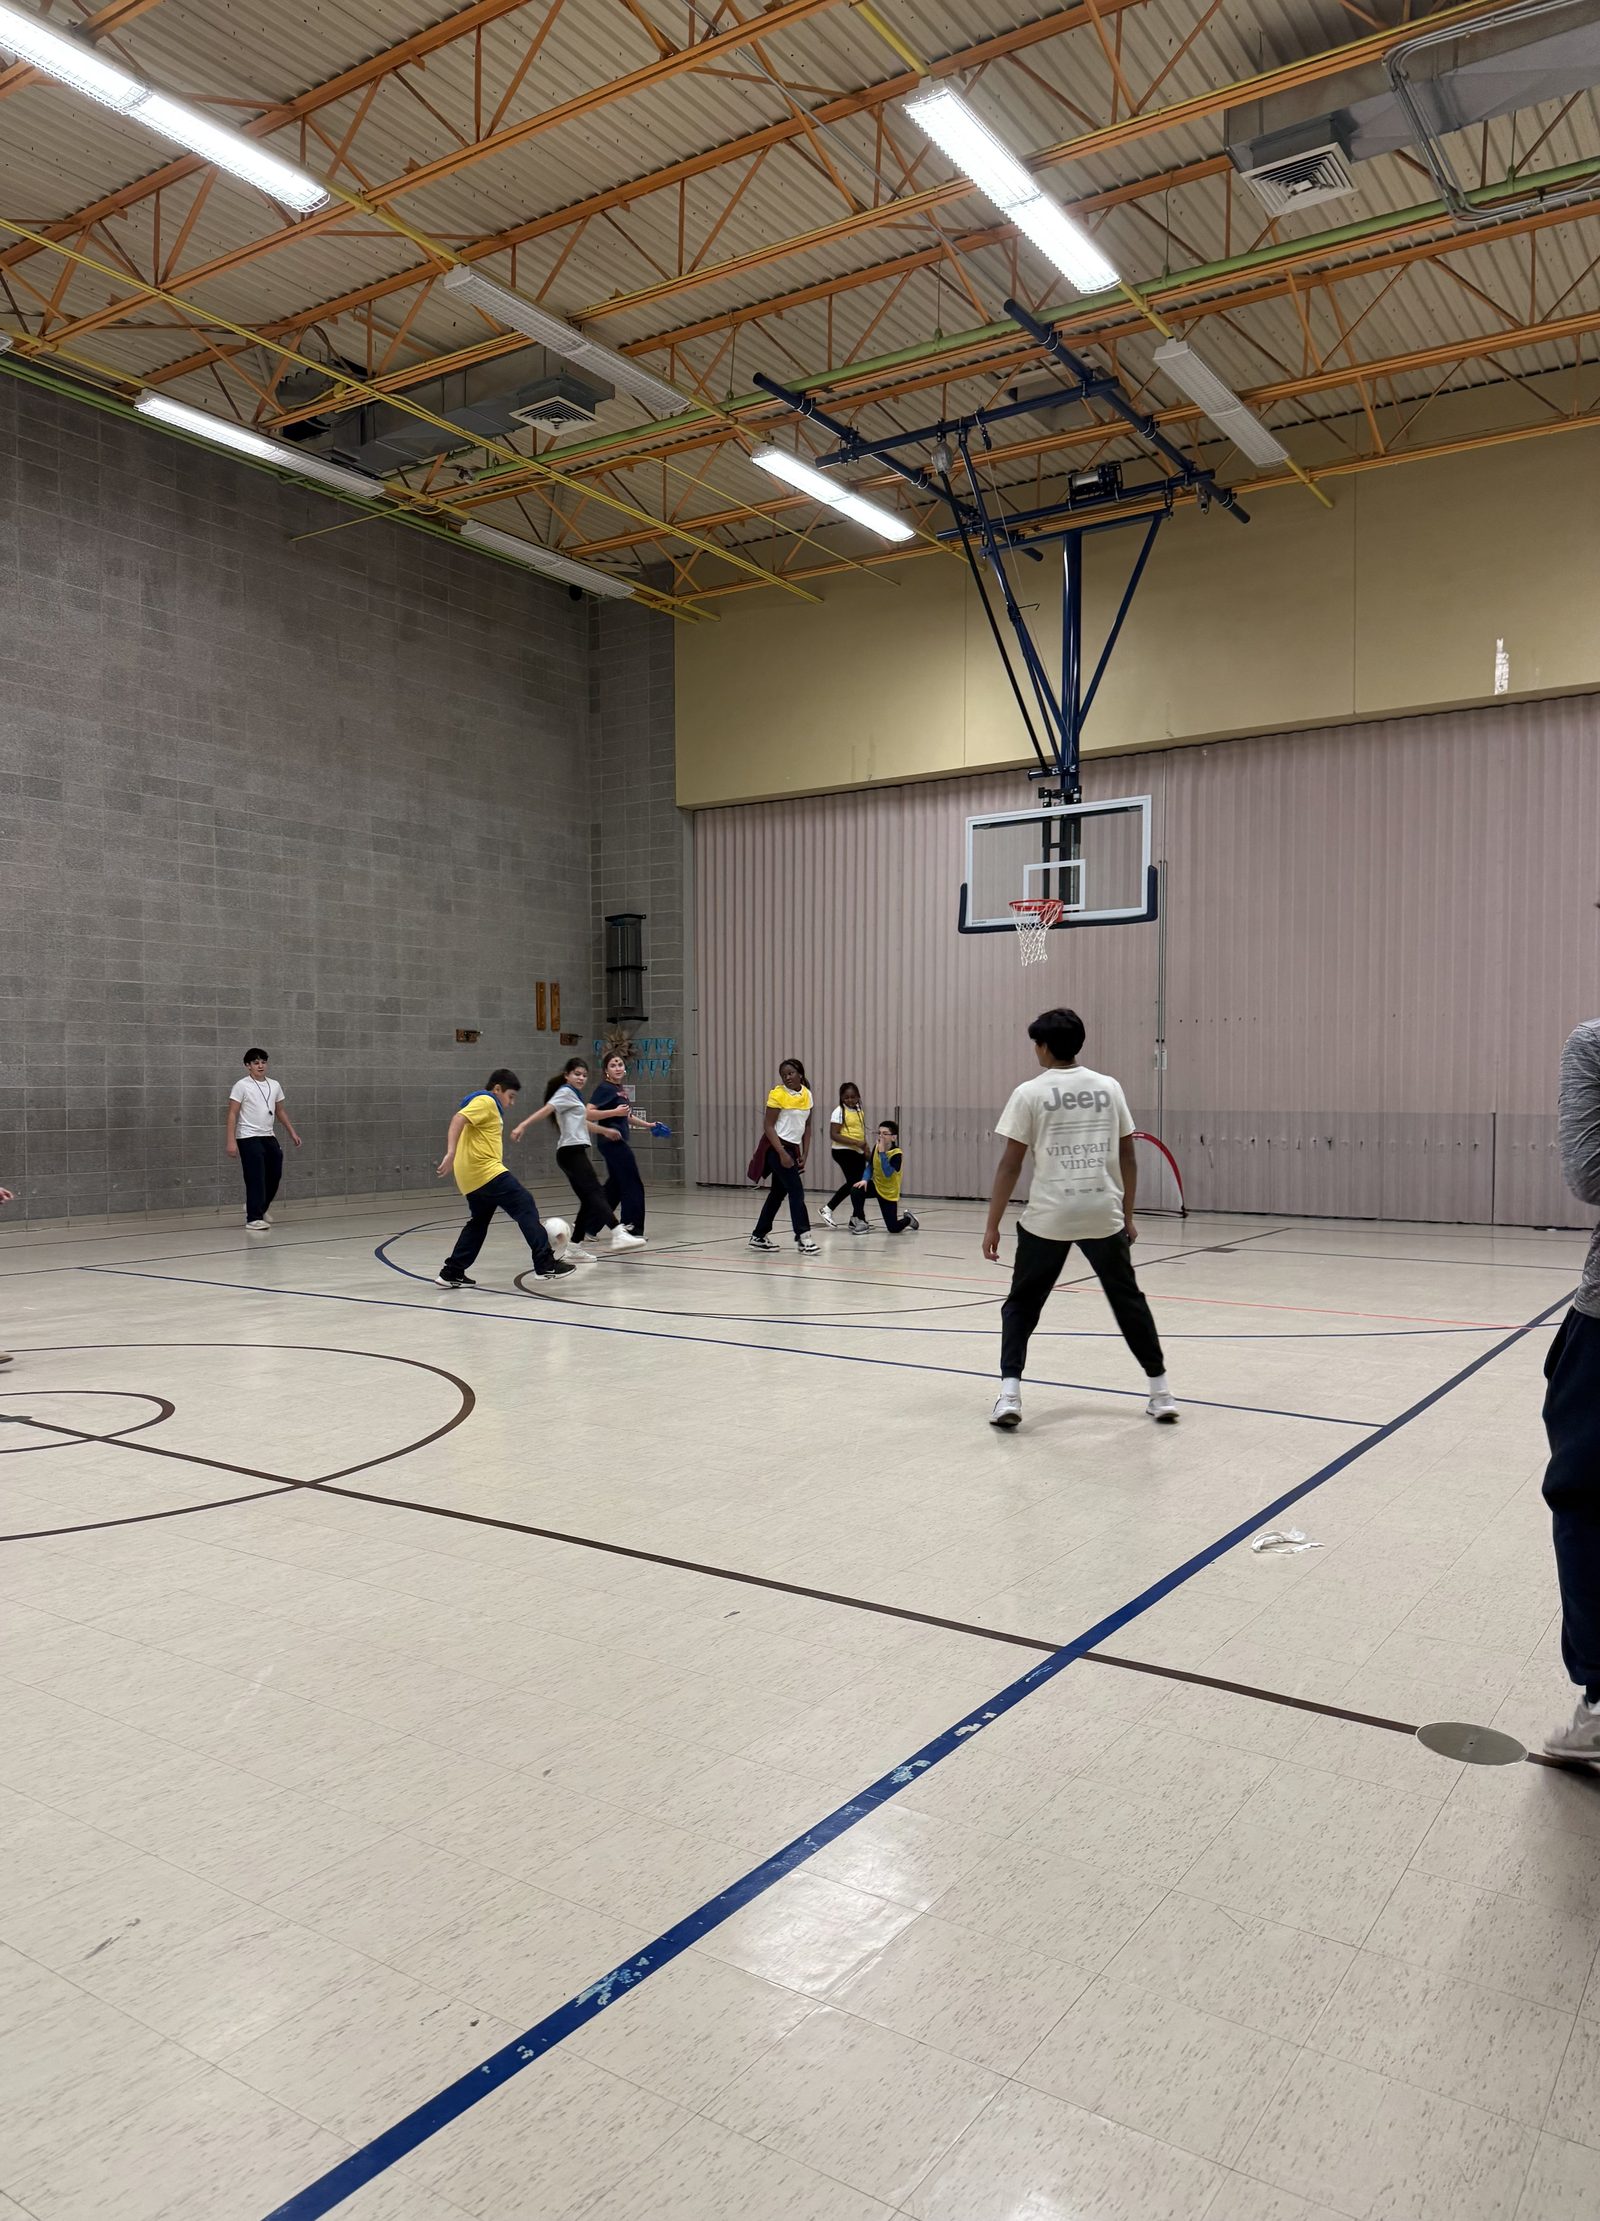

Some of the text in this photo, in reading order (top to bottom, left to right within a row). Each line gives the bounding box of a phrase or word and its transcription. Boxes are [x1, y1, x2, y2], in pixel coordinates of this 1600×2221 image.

[594, 1038, 674, 1053] CING
[1043, 1087, 1111, 1113] Jeep
[1060, 1156, 1104, 1170] vines
